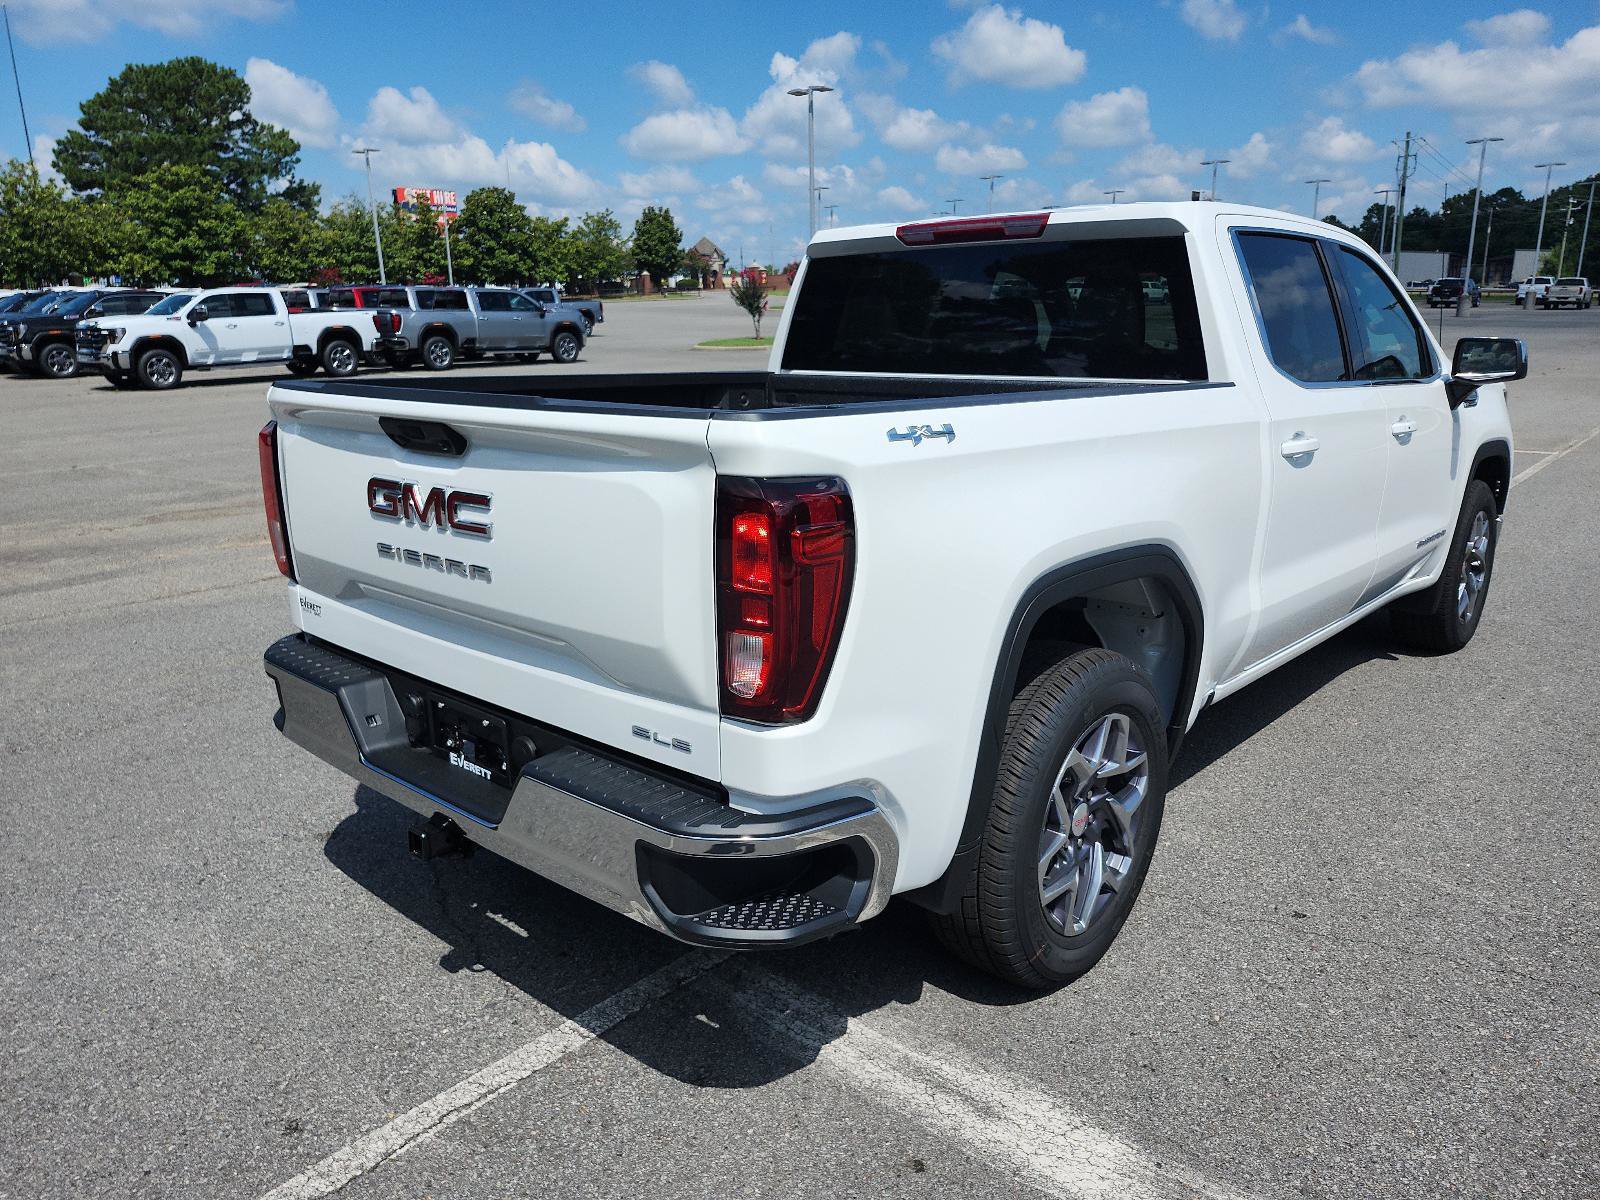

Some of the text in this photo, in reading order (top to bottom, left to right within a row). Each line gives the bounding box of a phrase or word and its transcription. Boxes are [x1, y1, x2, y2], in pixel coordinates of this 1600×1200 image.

[367, 476, 494, 542] GMC
[377, 542, 492, 584] SIERRA
[300, 596, 322, 613] EVERETT
[632, 725, 692, 754] SLE
[449, 751, 492, 780] EVERETT
